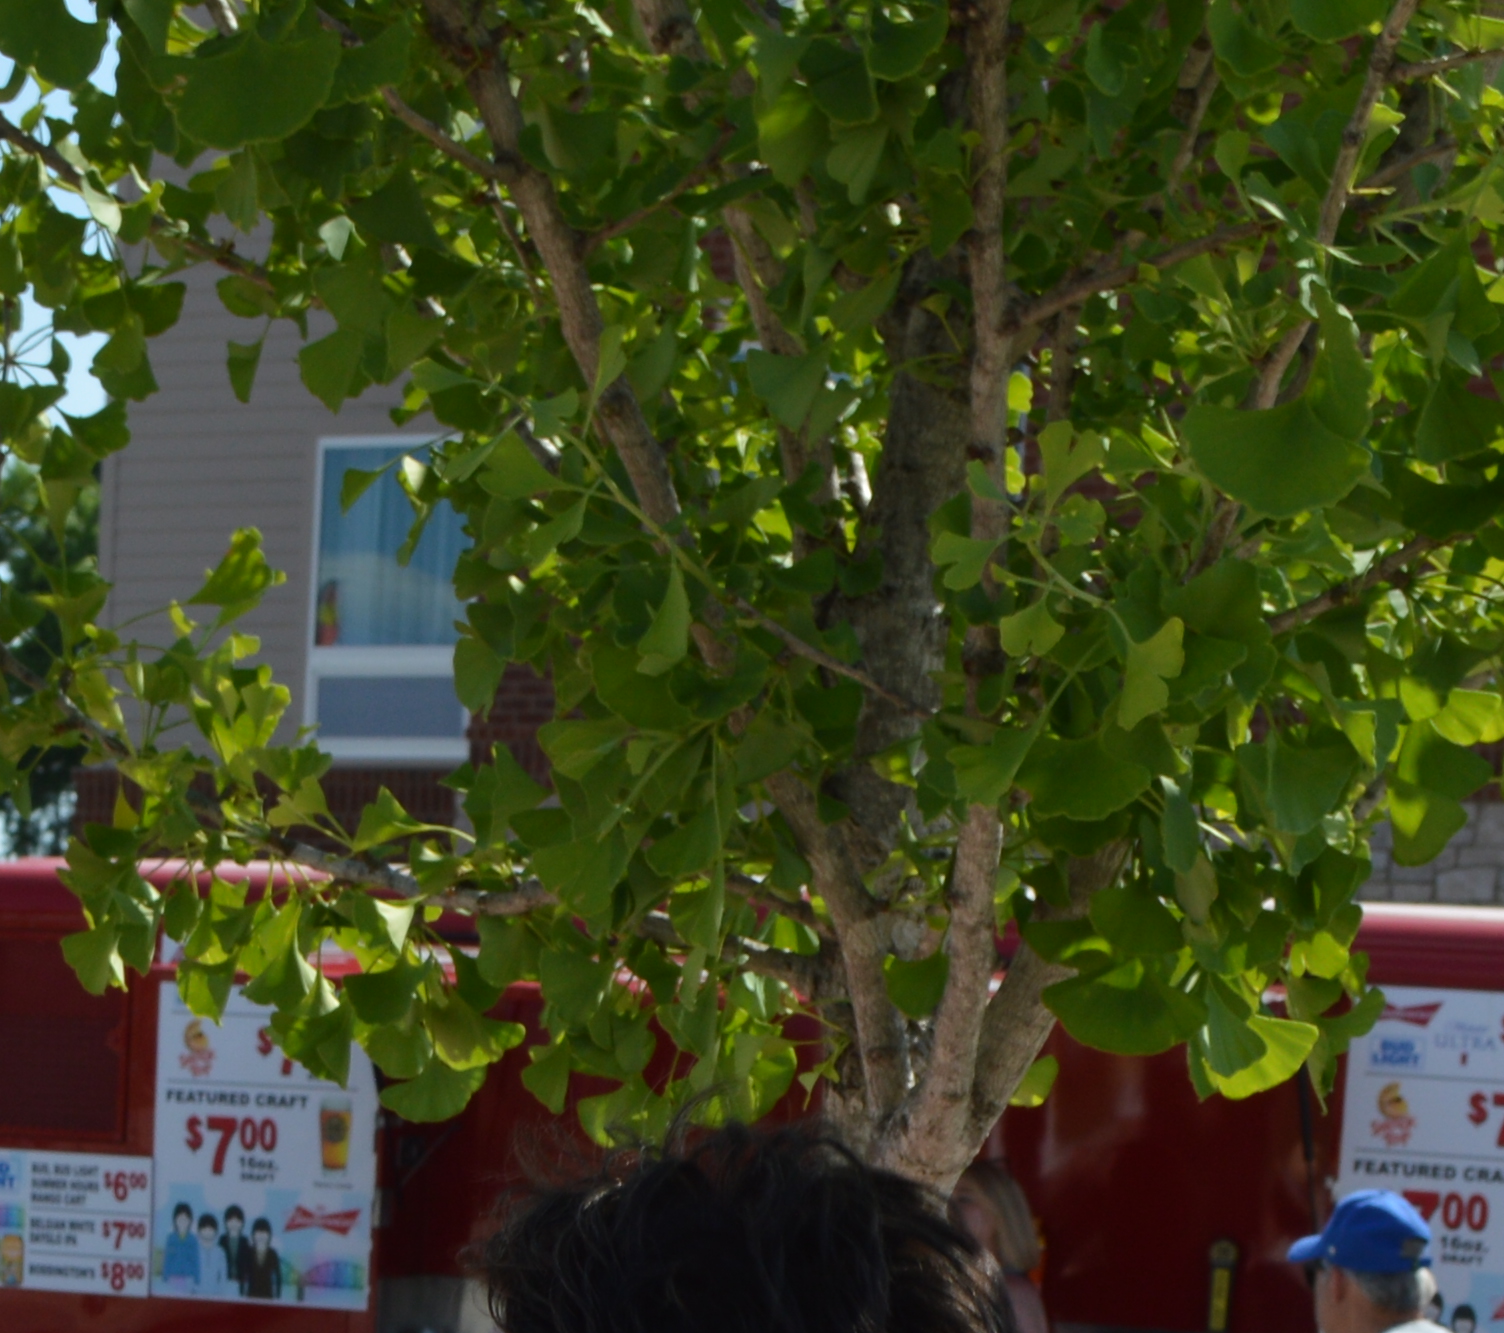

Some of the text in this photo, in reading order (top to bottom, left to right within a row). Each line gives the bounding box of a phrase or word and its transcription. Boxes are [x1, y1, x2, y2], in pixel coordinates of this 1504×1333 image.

[166, 1089, 309, 1109] FEATURED CRAFT
[1353, 1160, 1457, 1181] FEATURED
